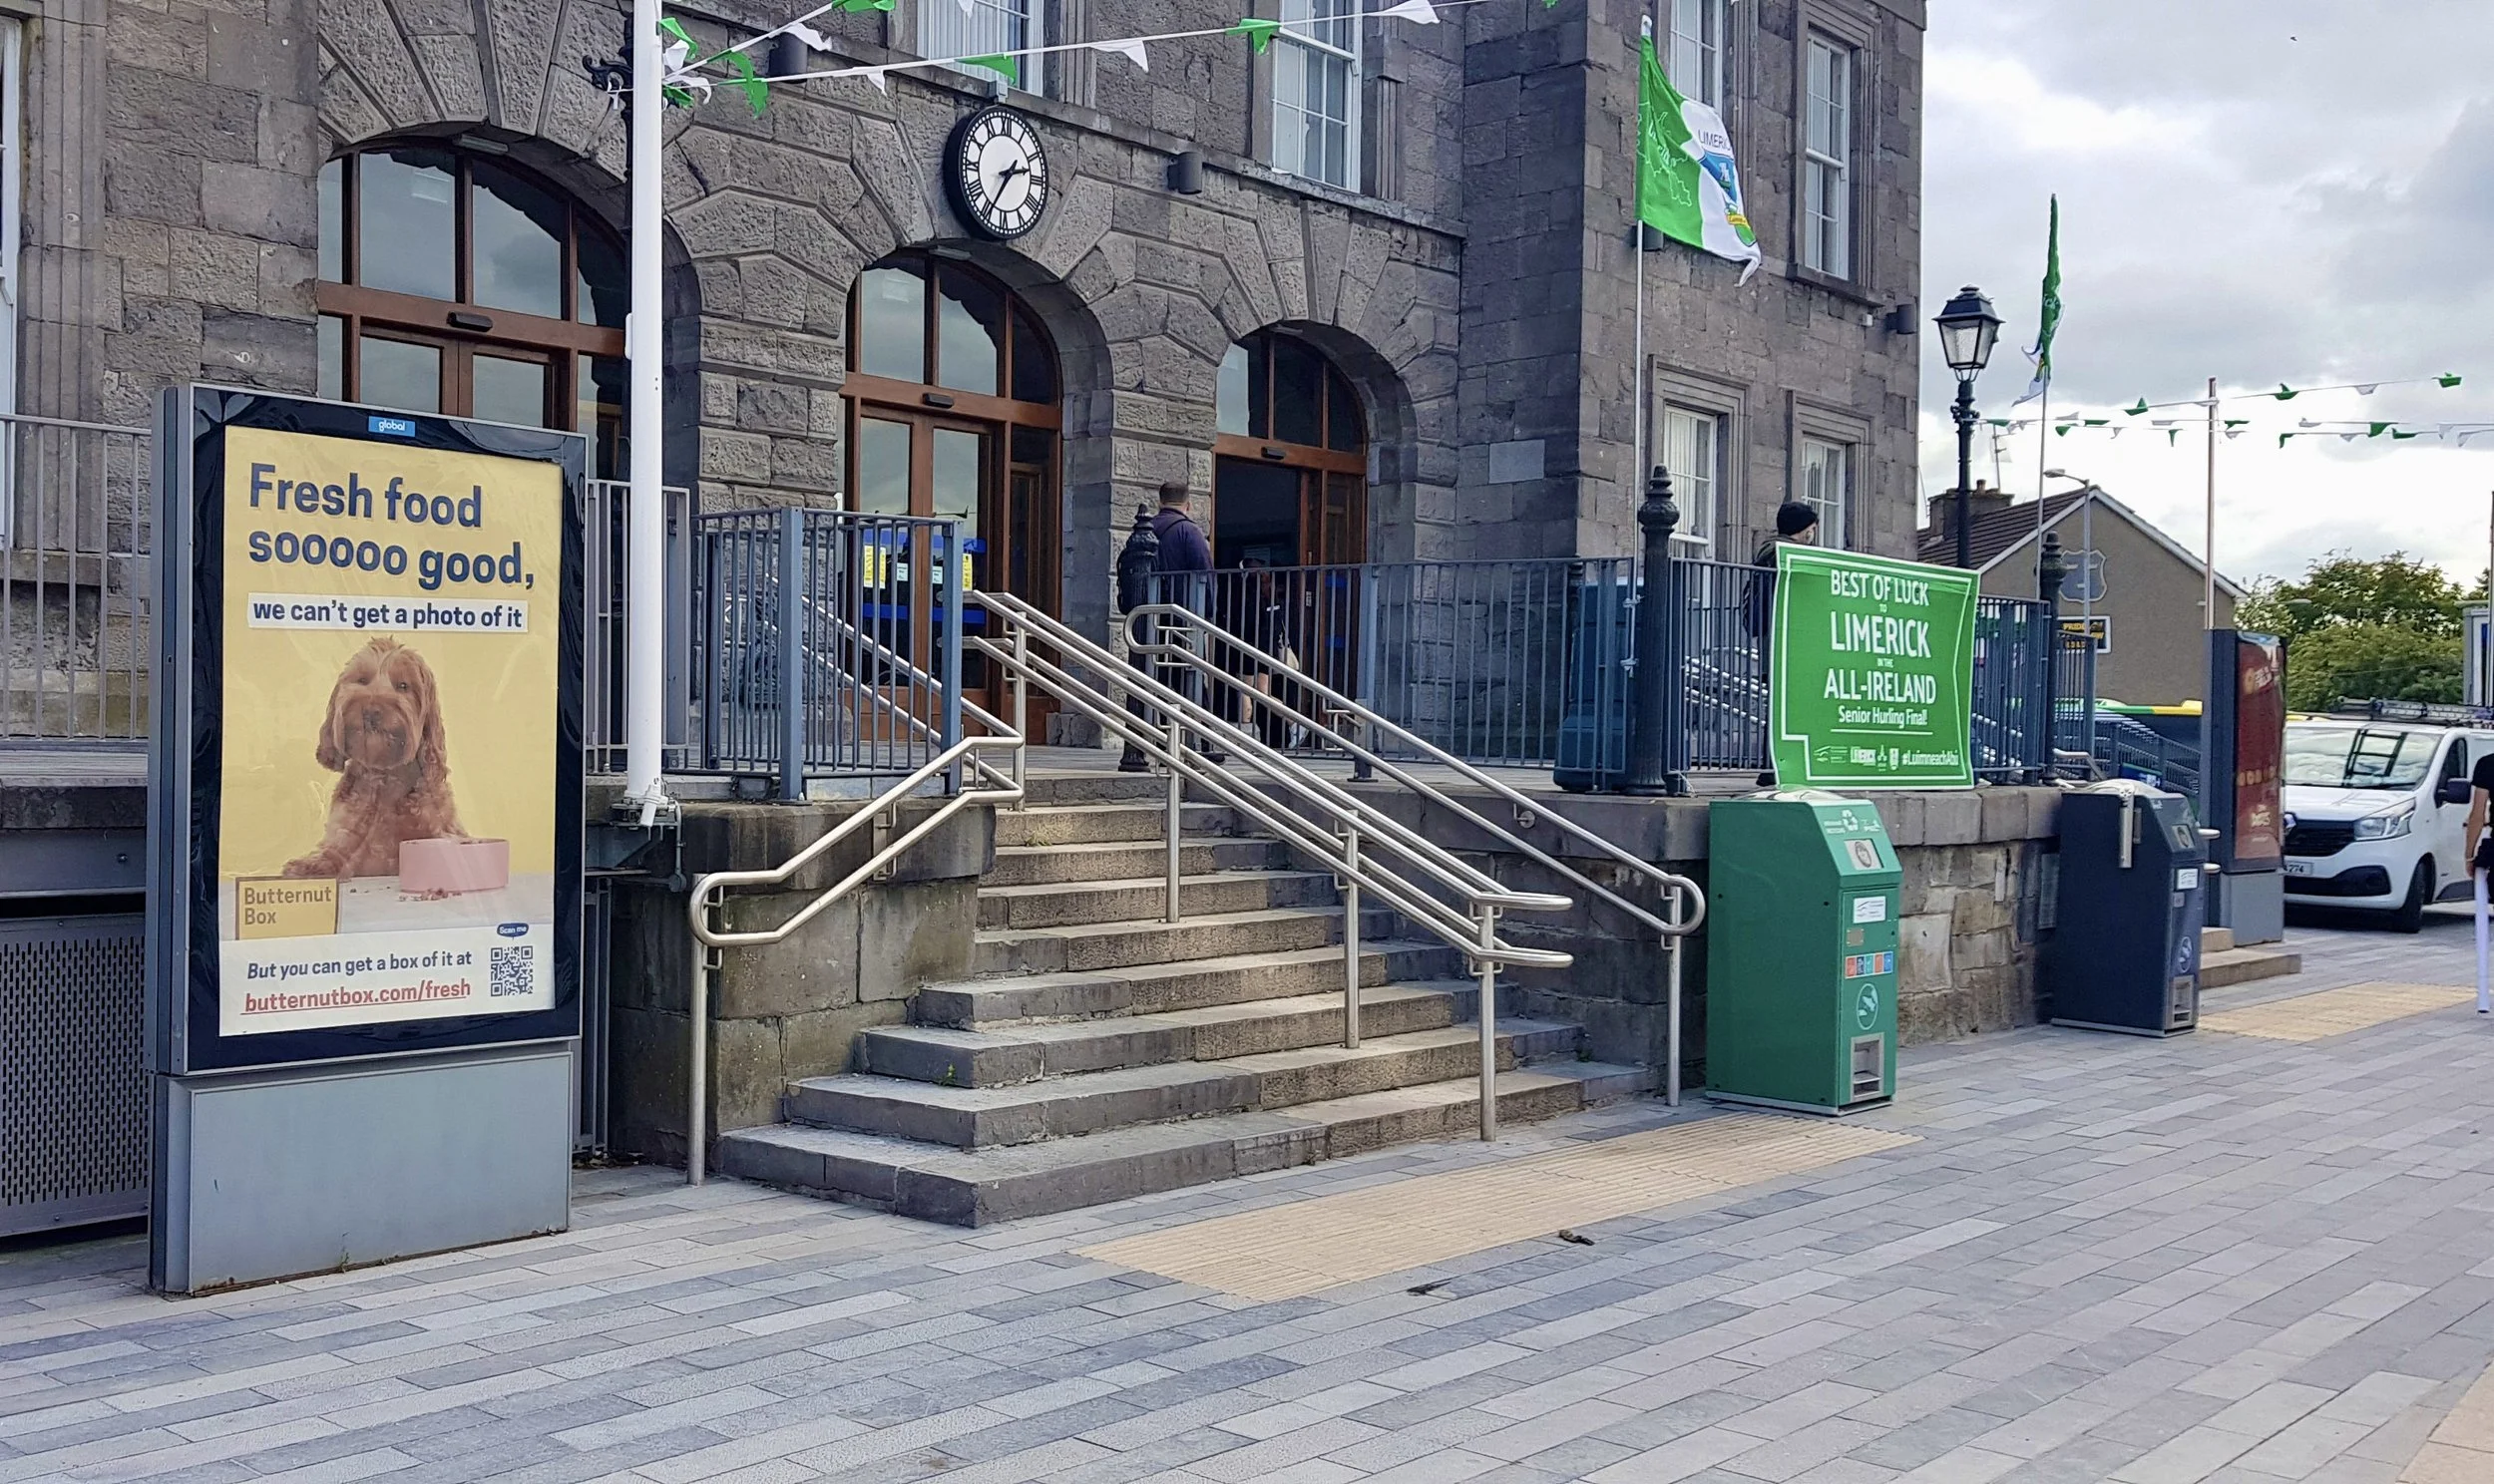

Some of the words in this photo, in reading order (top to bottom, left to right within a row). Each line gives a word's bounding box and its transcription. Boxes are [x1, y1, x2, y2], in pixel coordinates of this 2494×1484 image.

[379, 419, 406, 432] global
[249, 462, 373, 519] Fresh
[384, 477, 482, 528] food
[249, 531, 407, 575] sooooo
[418, 542, 535, 590] good,
[1831, 568, 1870, 598] BEST
[1872, 574, 1891, 600] OF
[1893, 577, 1929, 606] LUCK
[253, 602, 285, 620] we
[290, 599, 348, 622] can’t
[353, 604, 390, 628] get
[395, 607, 408, 624] a
[413, 602, 476, 629] photo
[481, 605, 503, 626] of
[507, 605, 523, 628] it
[1831, 610, 1932, 658] LIMERICK
[1824, 668, 1936, 705] ALL-IRELAND
[1839, 705, 1871, 724] Senior
[1872, 706, 1905, 730] Hurling
[1906, 708, 1927, 726] Final!
[244, 887, 332, 906] Butternut
[244, 908, 276, 926] Box
[247, 962, 277, 979] But
[280, 964, 308, 980] you
[312, 960, 341, 975] can
[345, 956, 373, 976] get
[377, 959, 386, 970] a
[390, 953, 419, 970] box
[422, 950, 439, 968] of
[441, 950, 453, 966] it
[456, 950, 472, 966] at
[243, 977, 471, 1013] butternutbox.com/fresh
